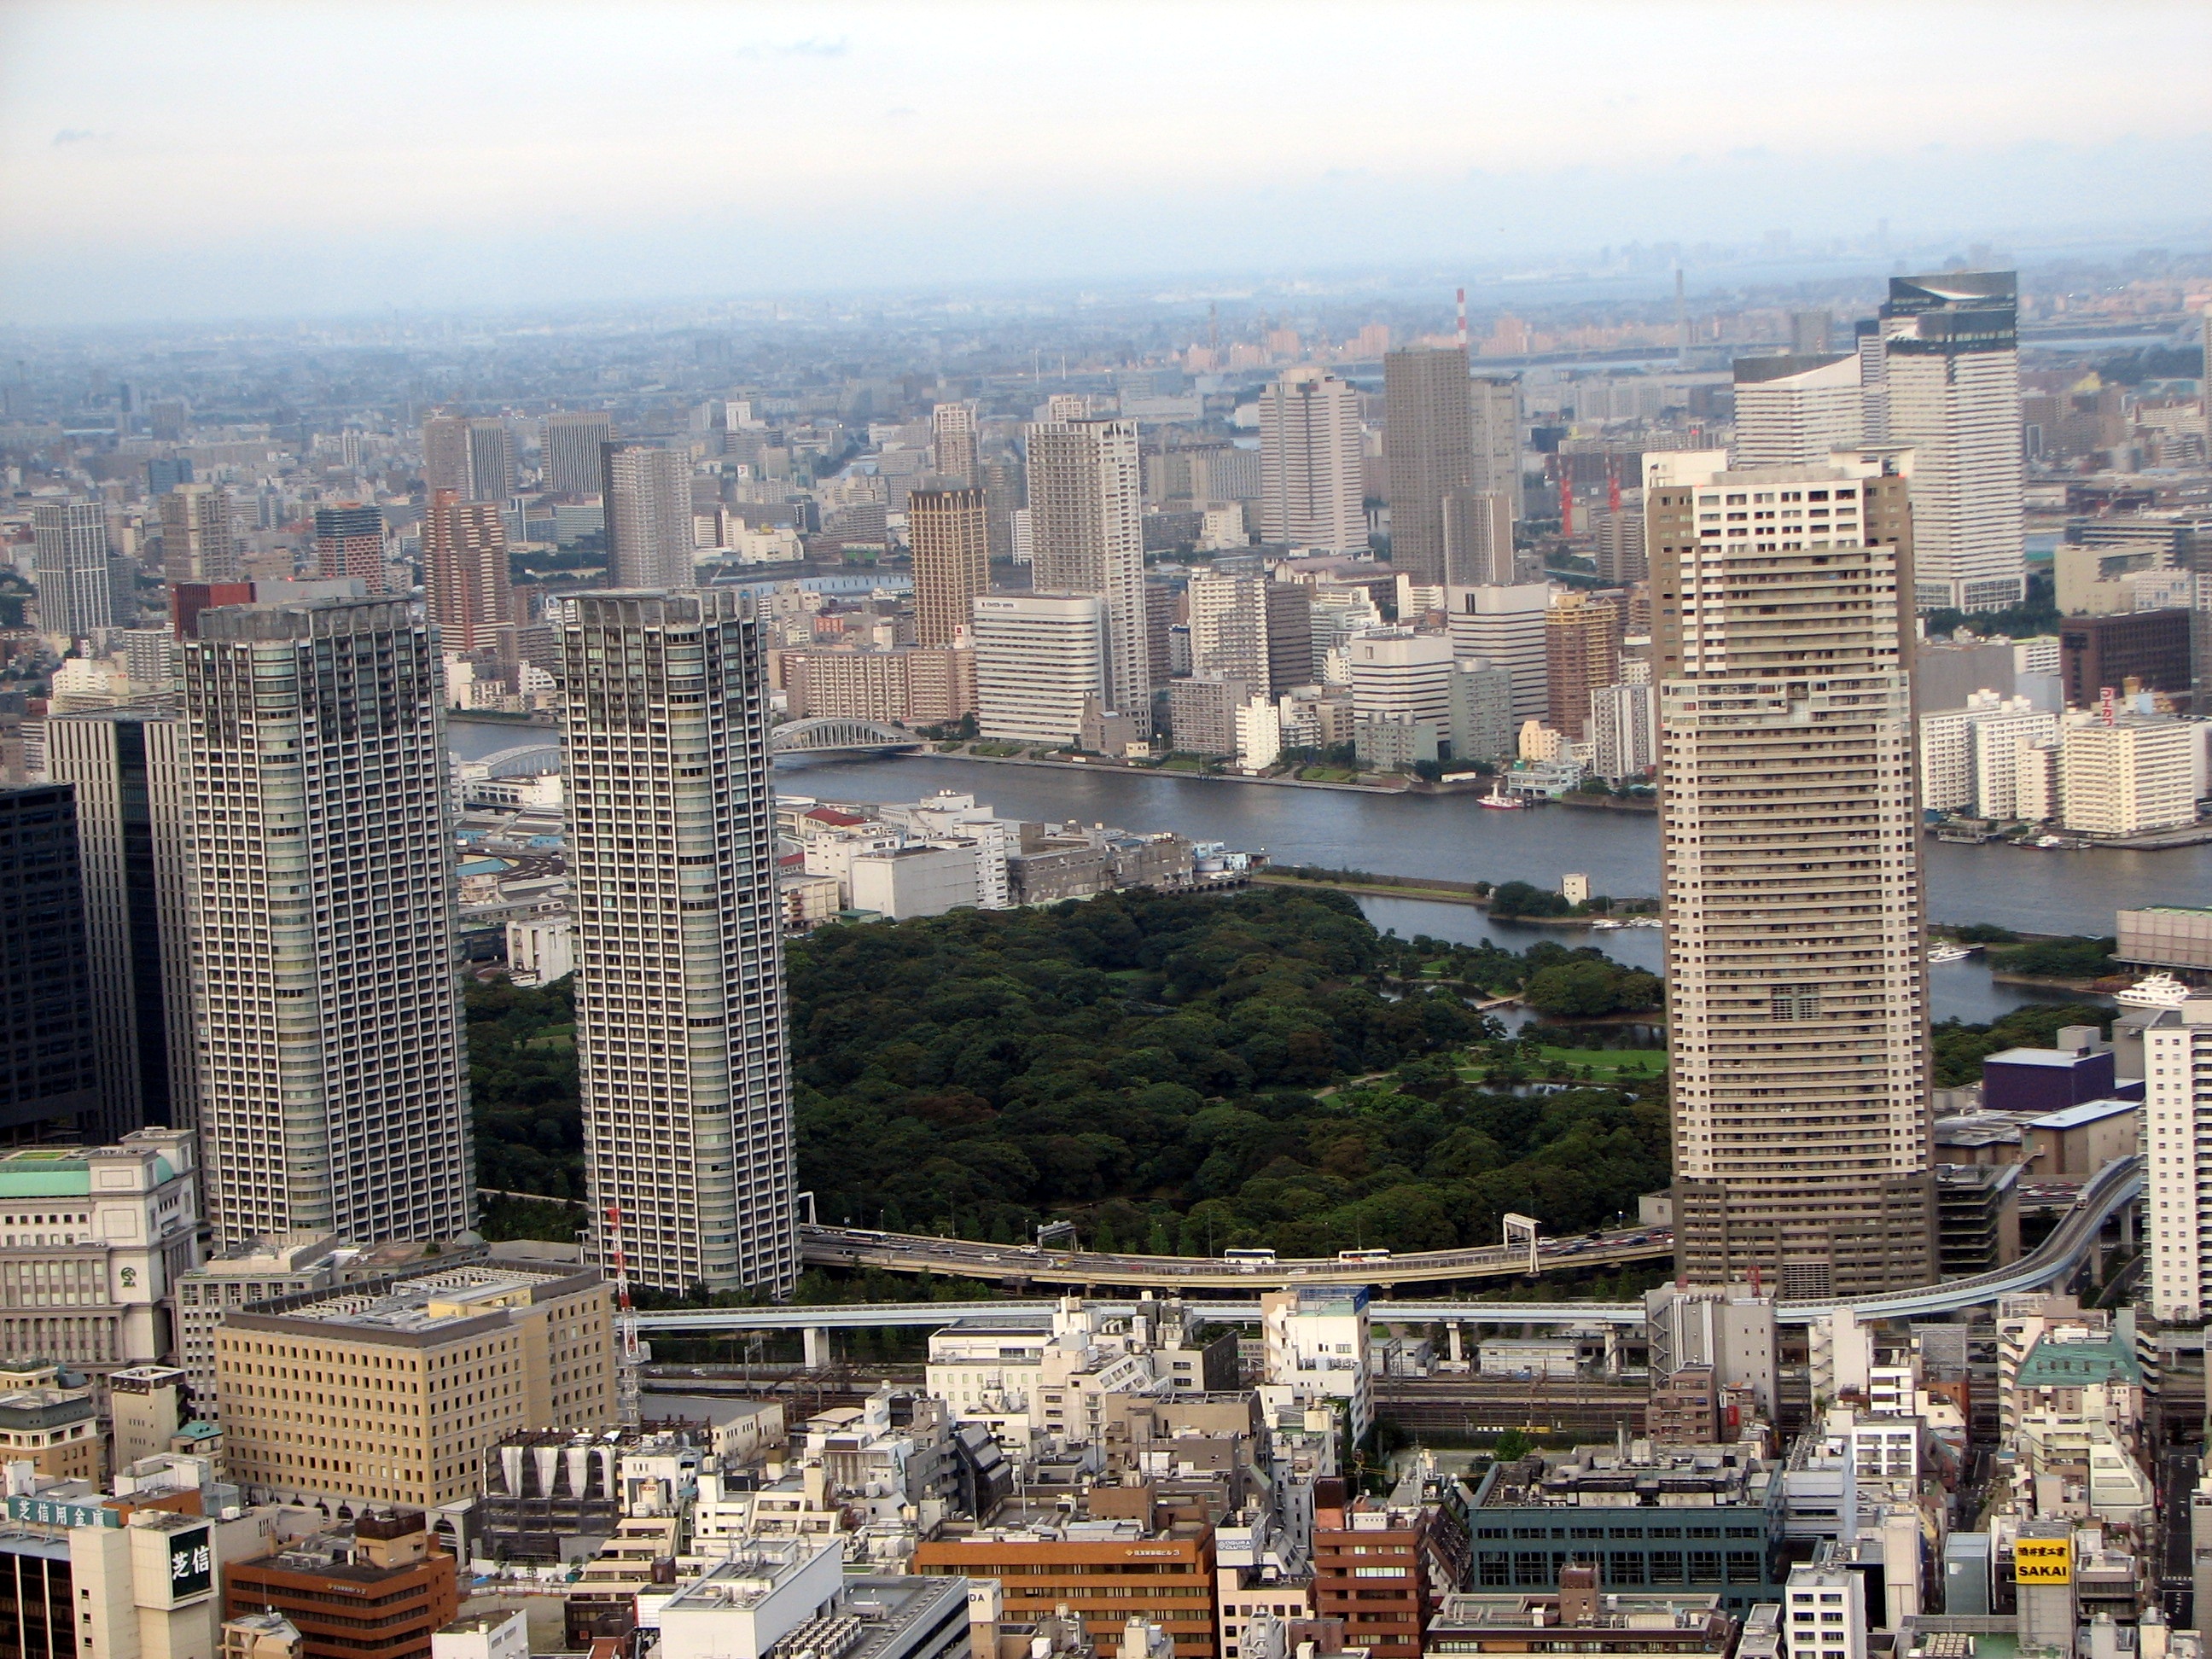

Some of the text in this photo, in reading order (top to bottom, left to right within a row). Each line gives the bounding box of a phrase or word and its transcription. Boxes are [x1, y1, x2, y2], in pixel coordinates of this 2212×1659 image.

[19, 1500, 105, 1528] 芝信用金庫
[172, 1545, 210, 1580] 芝信
[2018, 1566, 2066, 1576] SAKAI
[969, 1593, 985, 1602] DA
